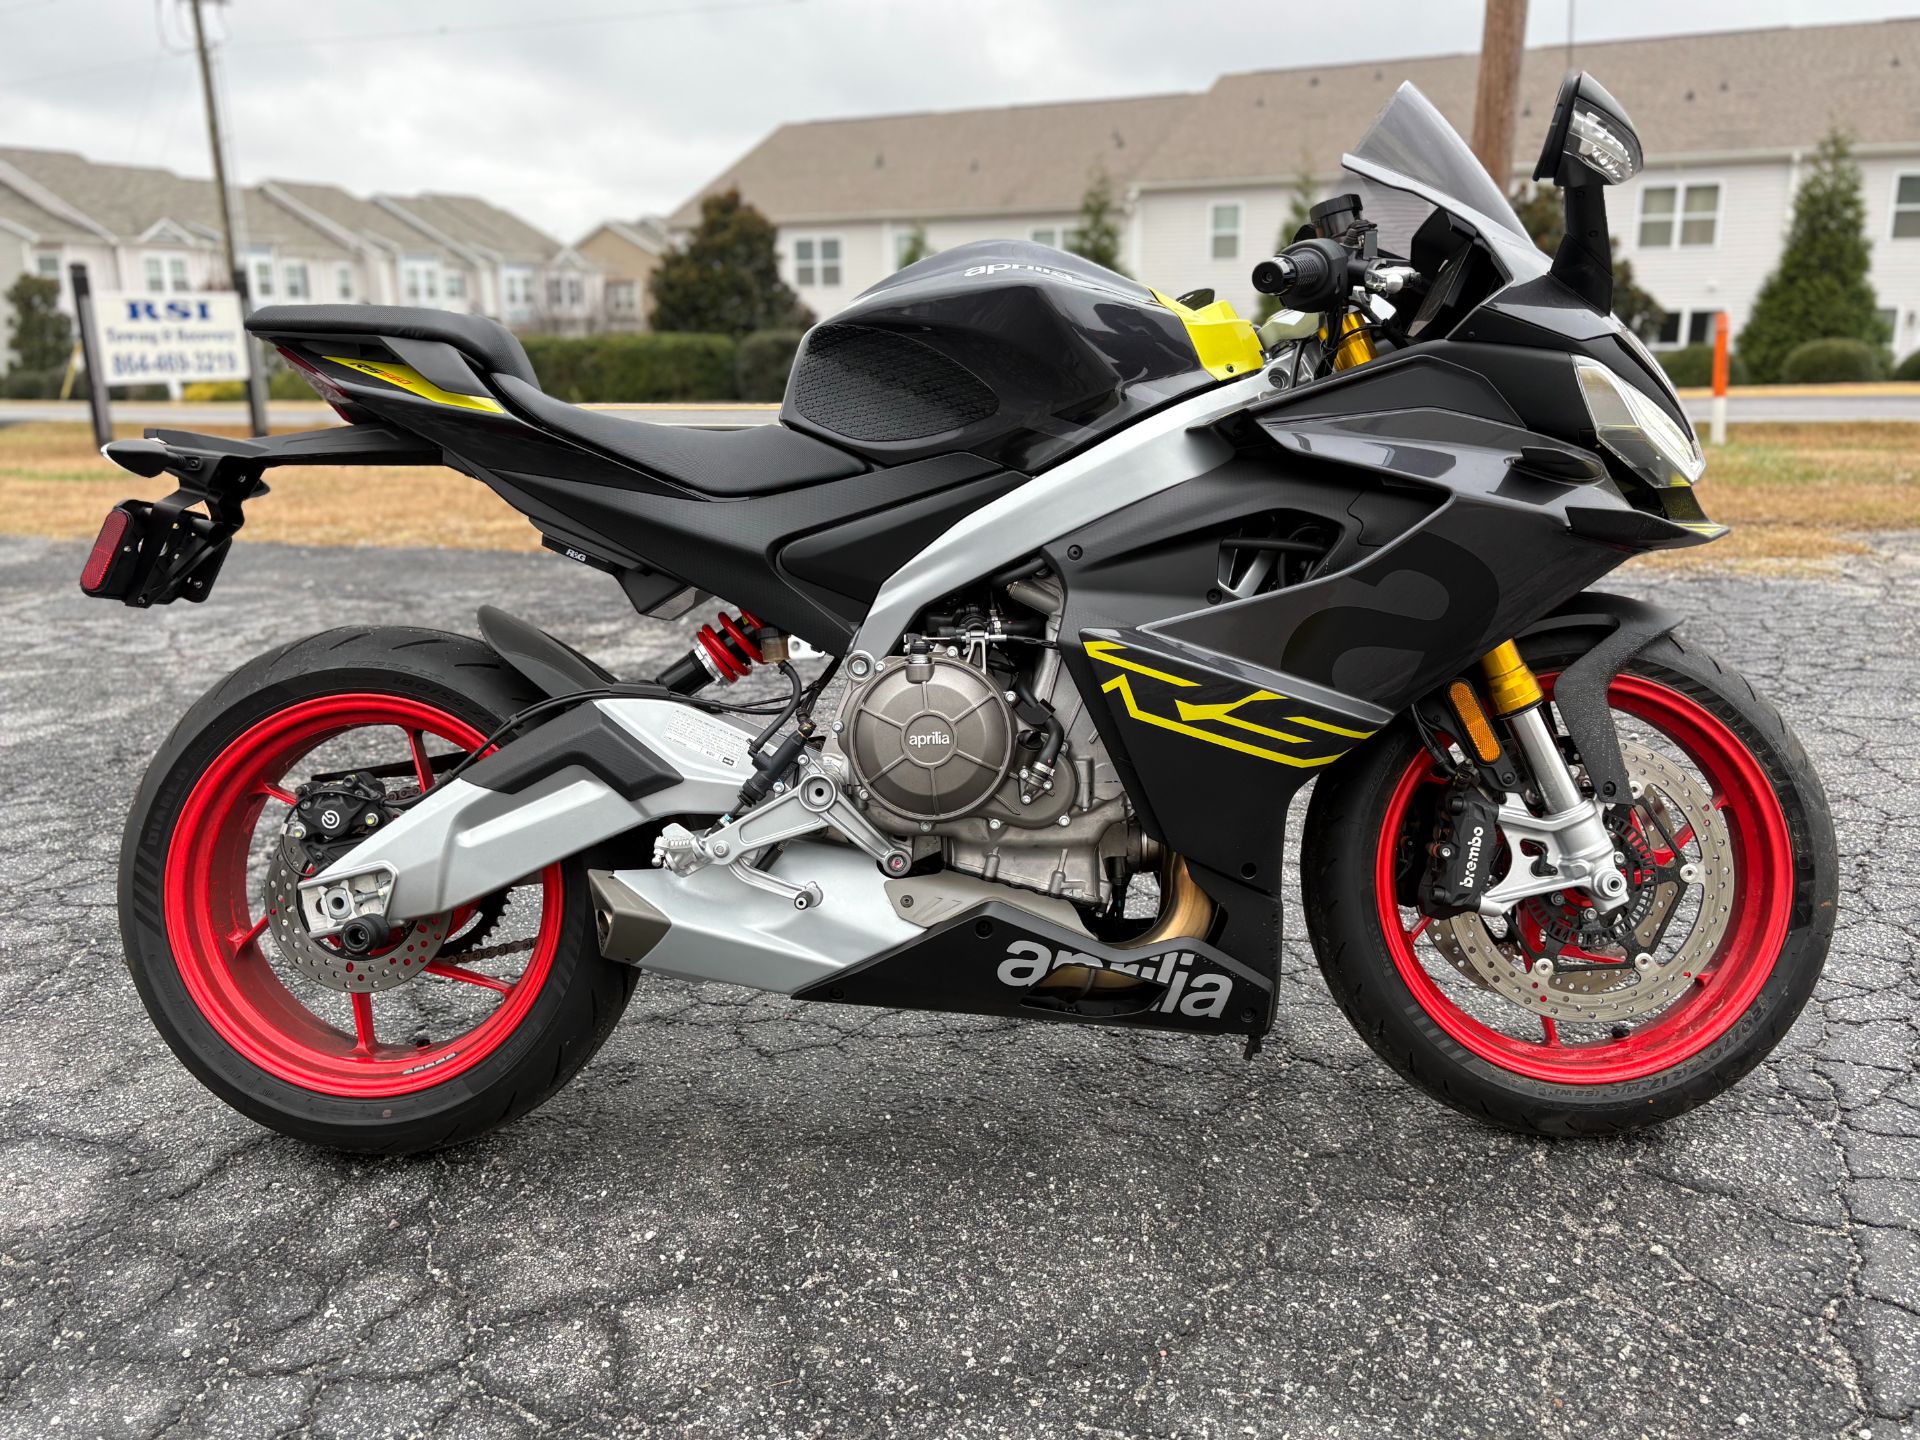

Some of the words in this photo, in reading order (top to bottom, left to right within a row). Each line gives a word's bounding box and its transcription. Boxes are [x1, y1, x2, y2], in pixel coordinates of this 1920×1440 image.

[126, 301, 210, 321] RSI
[565, 548, 587, 562] R&G
[908, 731, 950, 748] aprilia
[1459, 826, 1484, 888] brembo
